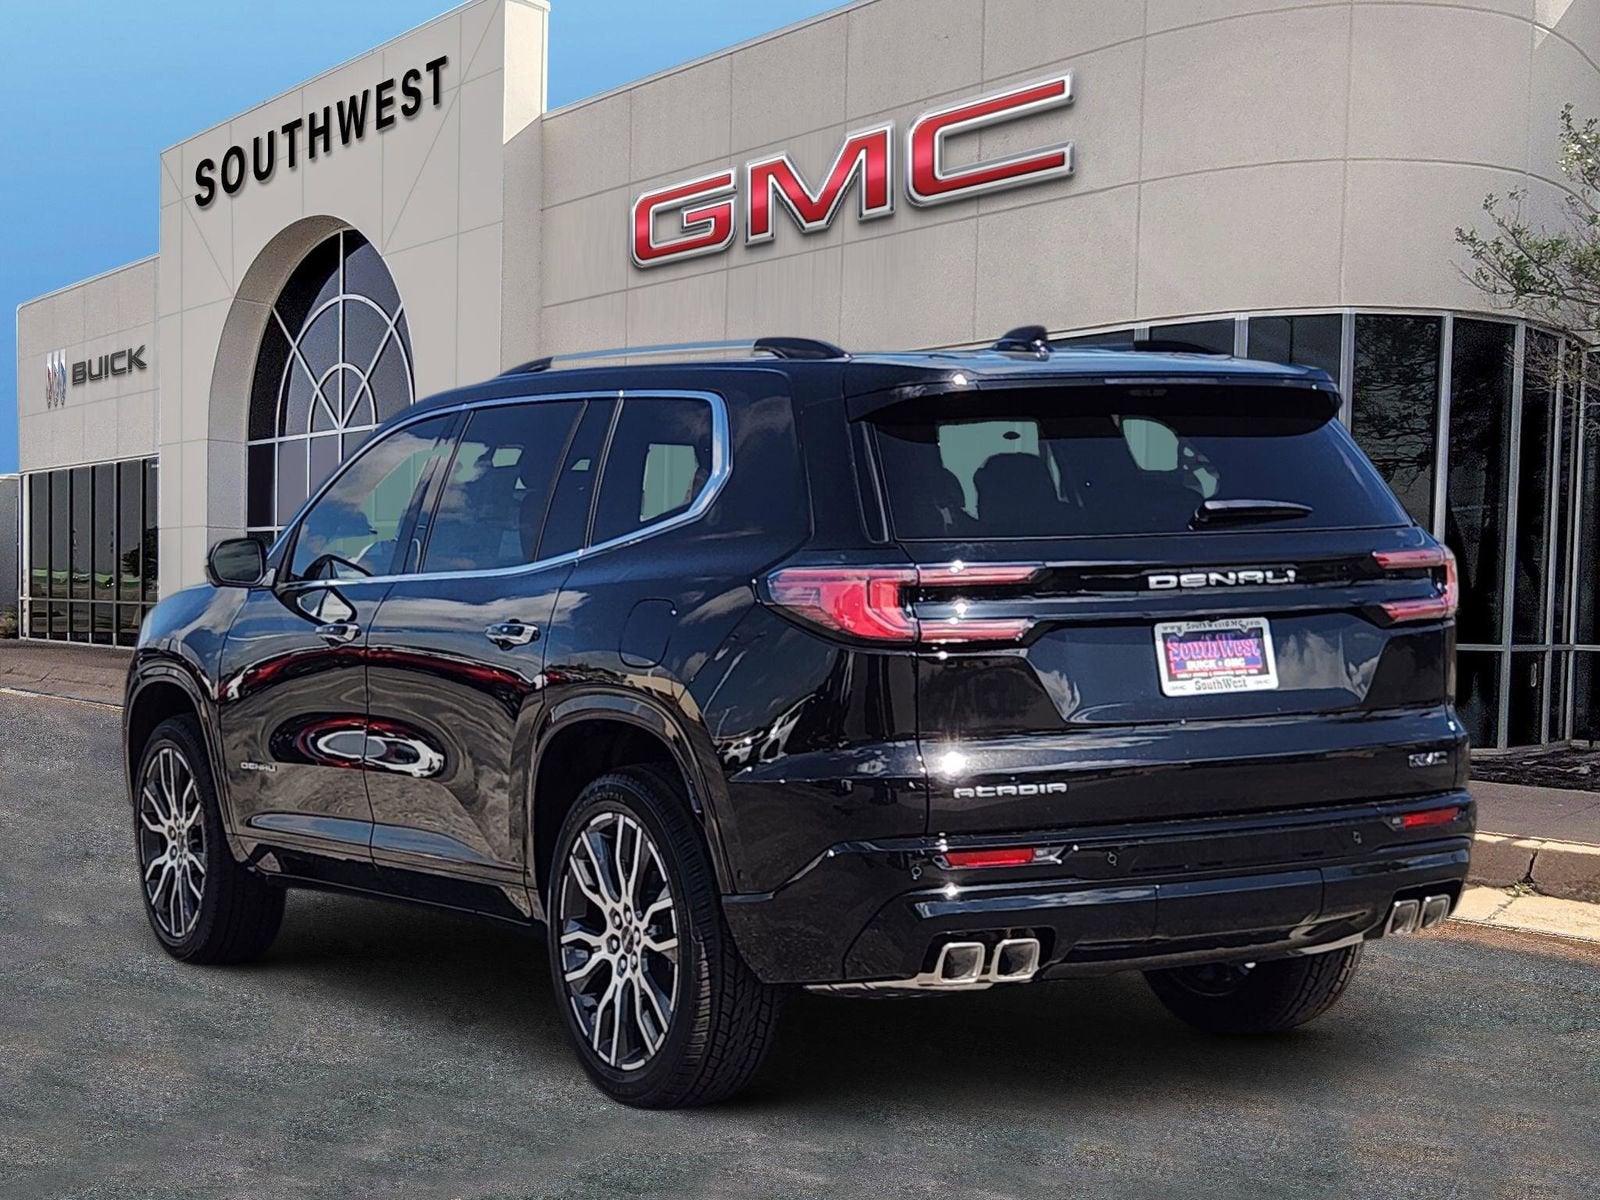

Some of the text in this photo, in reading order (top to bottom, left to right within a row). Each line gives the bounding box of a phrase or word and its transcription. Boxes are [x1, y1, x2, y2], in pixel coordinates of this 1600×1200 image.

[194, 55, 449, 207] SOUTHWEST
[630, 69, 1075, 269] GMC
[72, 344, 147, 385] BUICK
[1148, 570, 1296, 589] DENALI
[1167, 632, 1262, 660] SouthWest
[1194, 677, 1248, 691] SouthWest
[953, 782, 1068, 798] ACADIA
